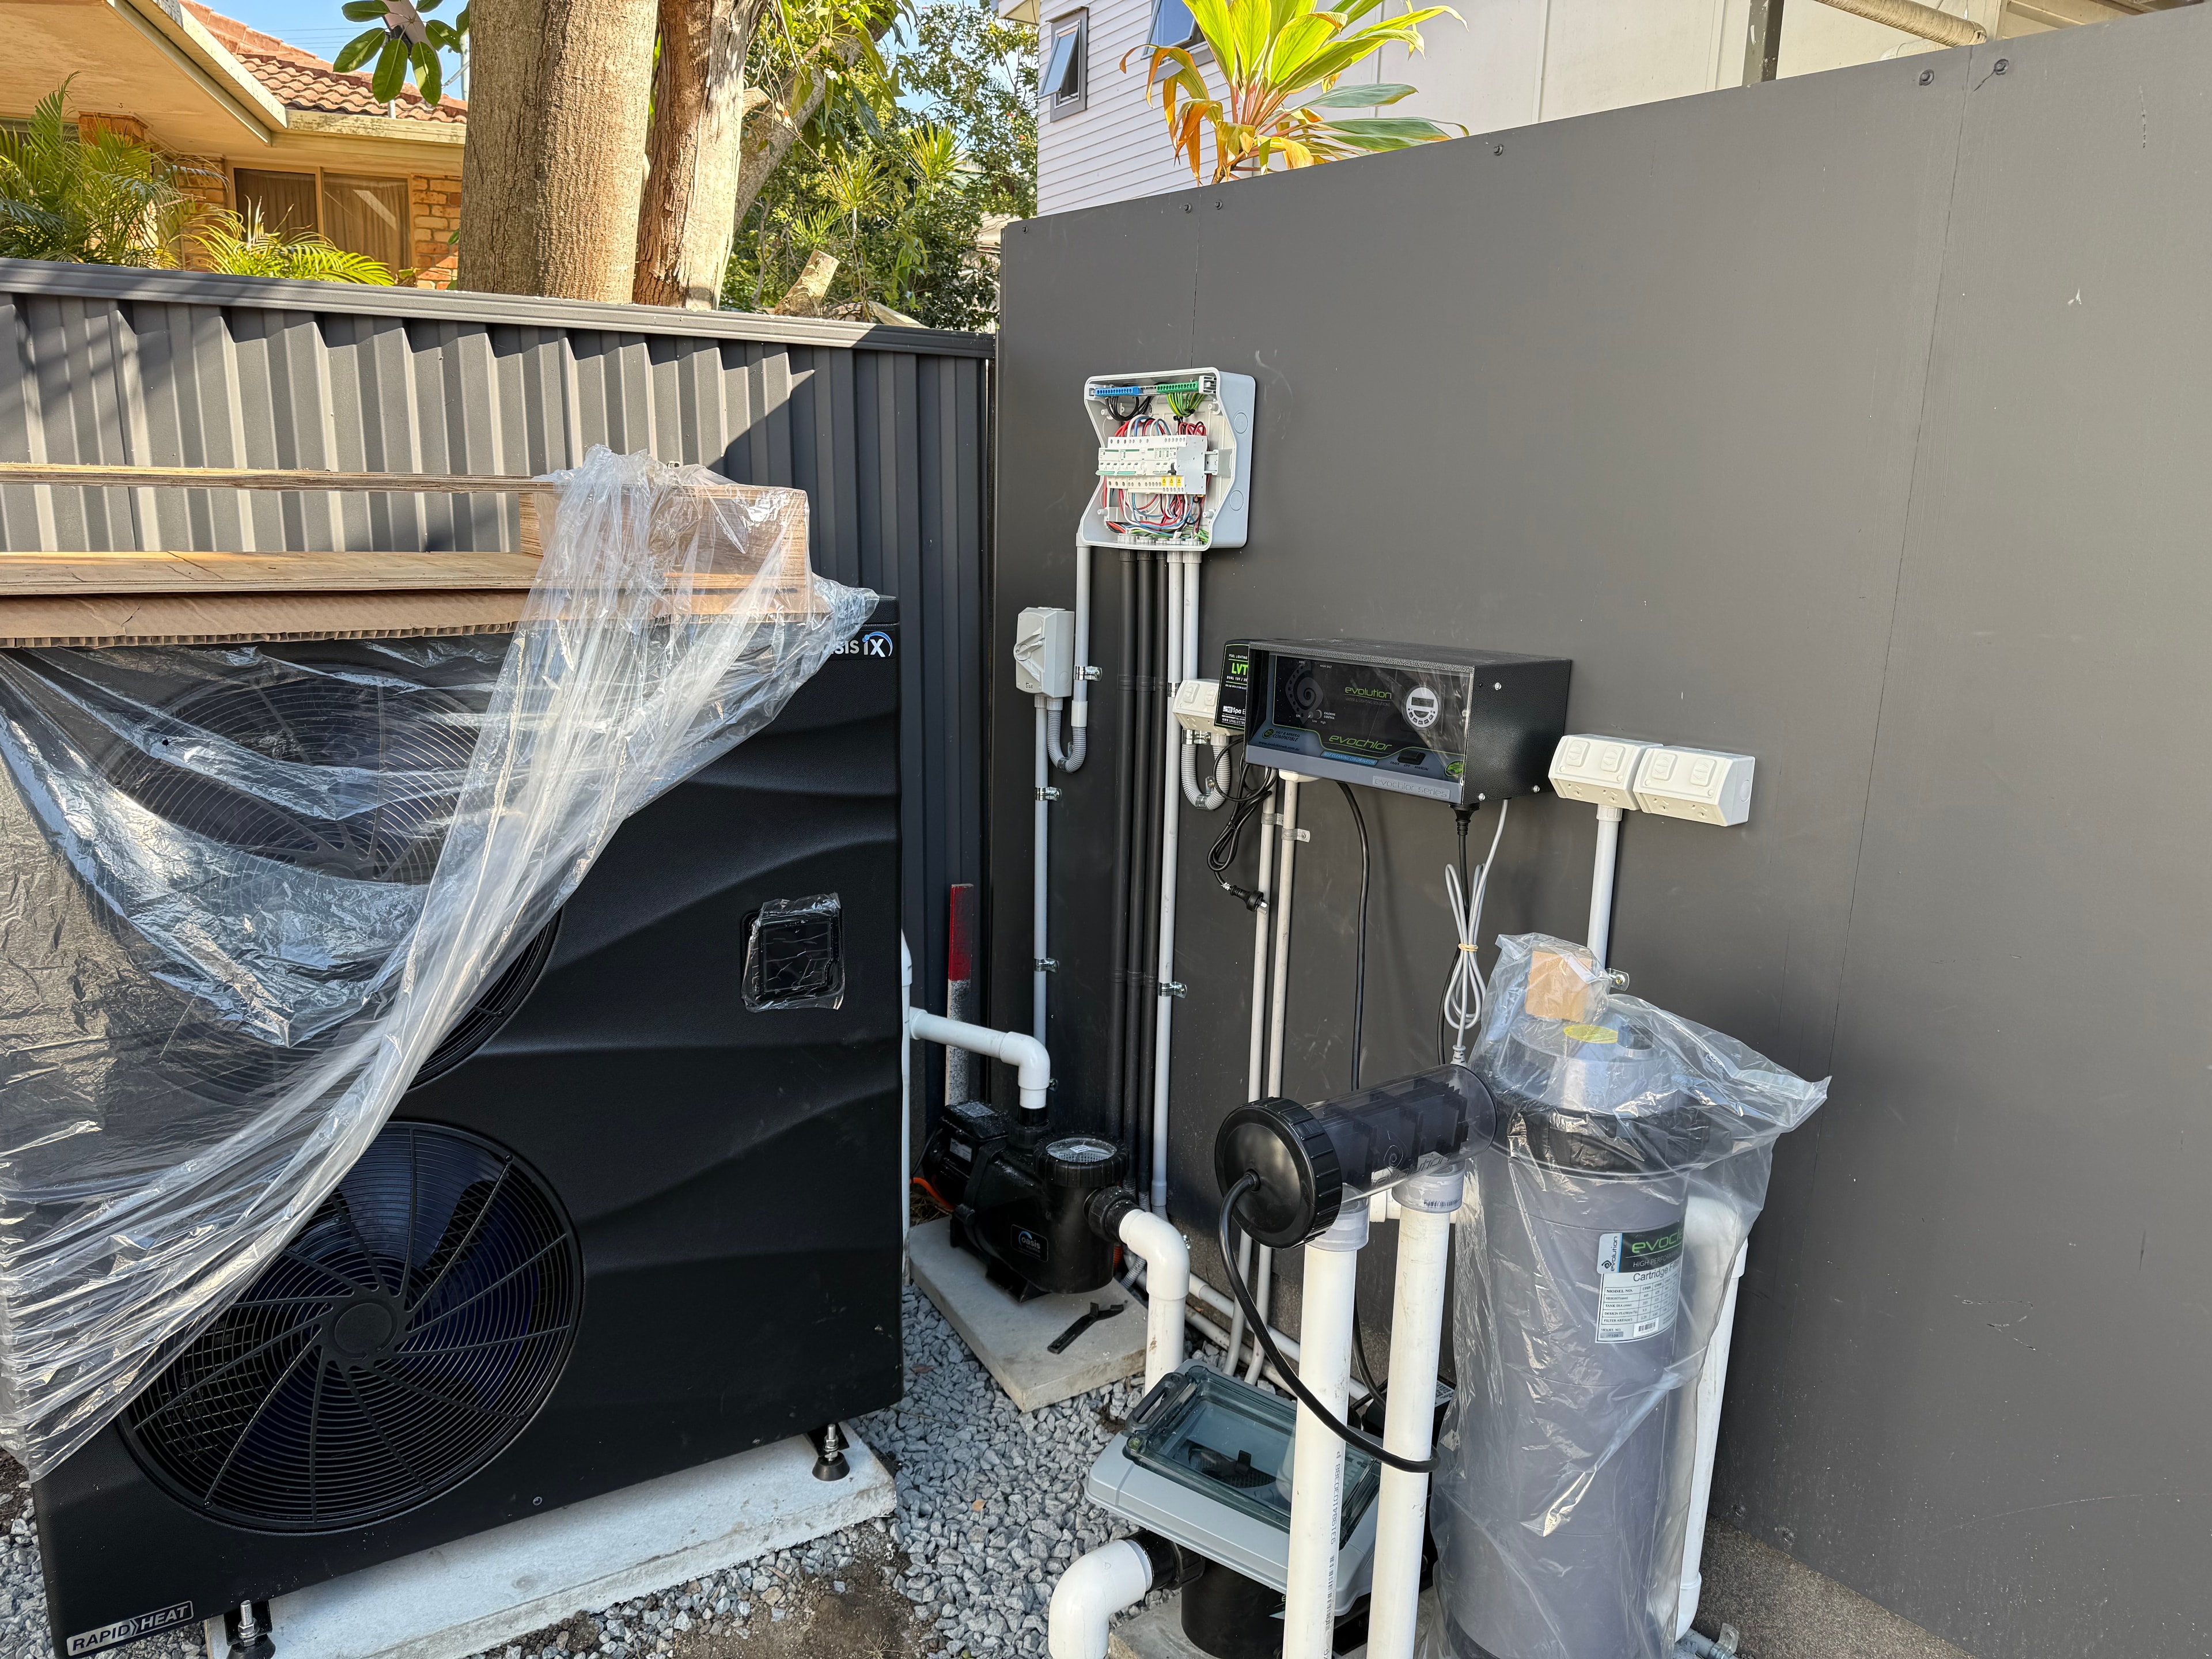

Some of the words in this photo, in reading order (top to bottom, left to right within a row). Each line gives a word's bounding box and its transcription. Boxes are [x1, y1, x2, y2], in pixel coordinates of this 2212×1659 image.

[1344, 687, 1392, 699] evolution
[1272, 733, 1298, 742] COMPATIBLE
[1328, 735, 1392, 751] evochlor
[1374, 778, 1415, 791] evochlor
[1418, 786, 1447, 798] series
[1021, 1237, 1040, 1249] oasis
[1610, 1236, 1618, 1272] evolution
[1633, 1260, 1649, 1268] HIGH
[1633, 1267, 1669, 1282] Cartridge
[73, 1624, 130, 1652] RAPID
[141, 1605, 188, 1631] HEAT
